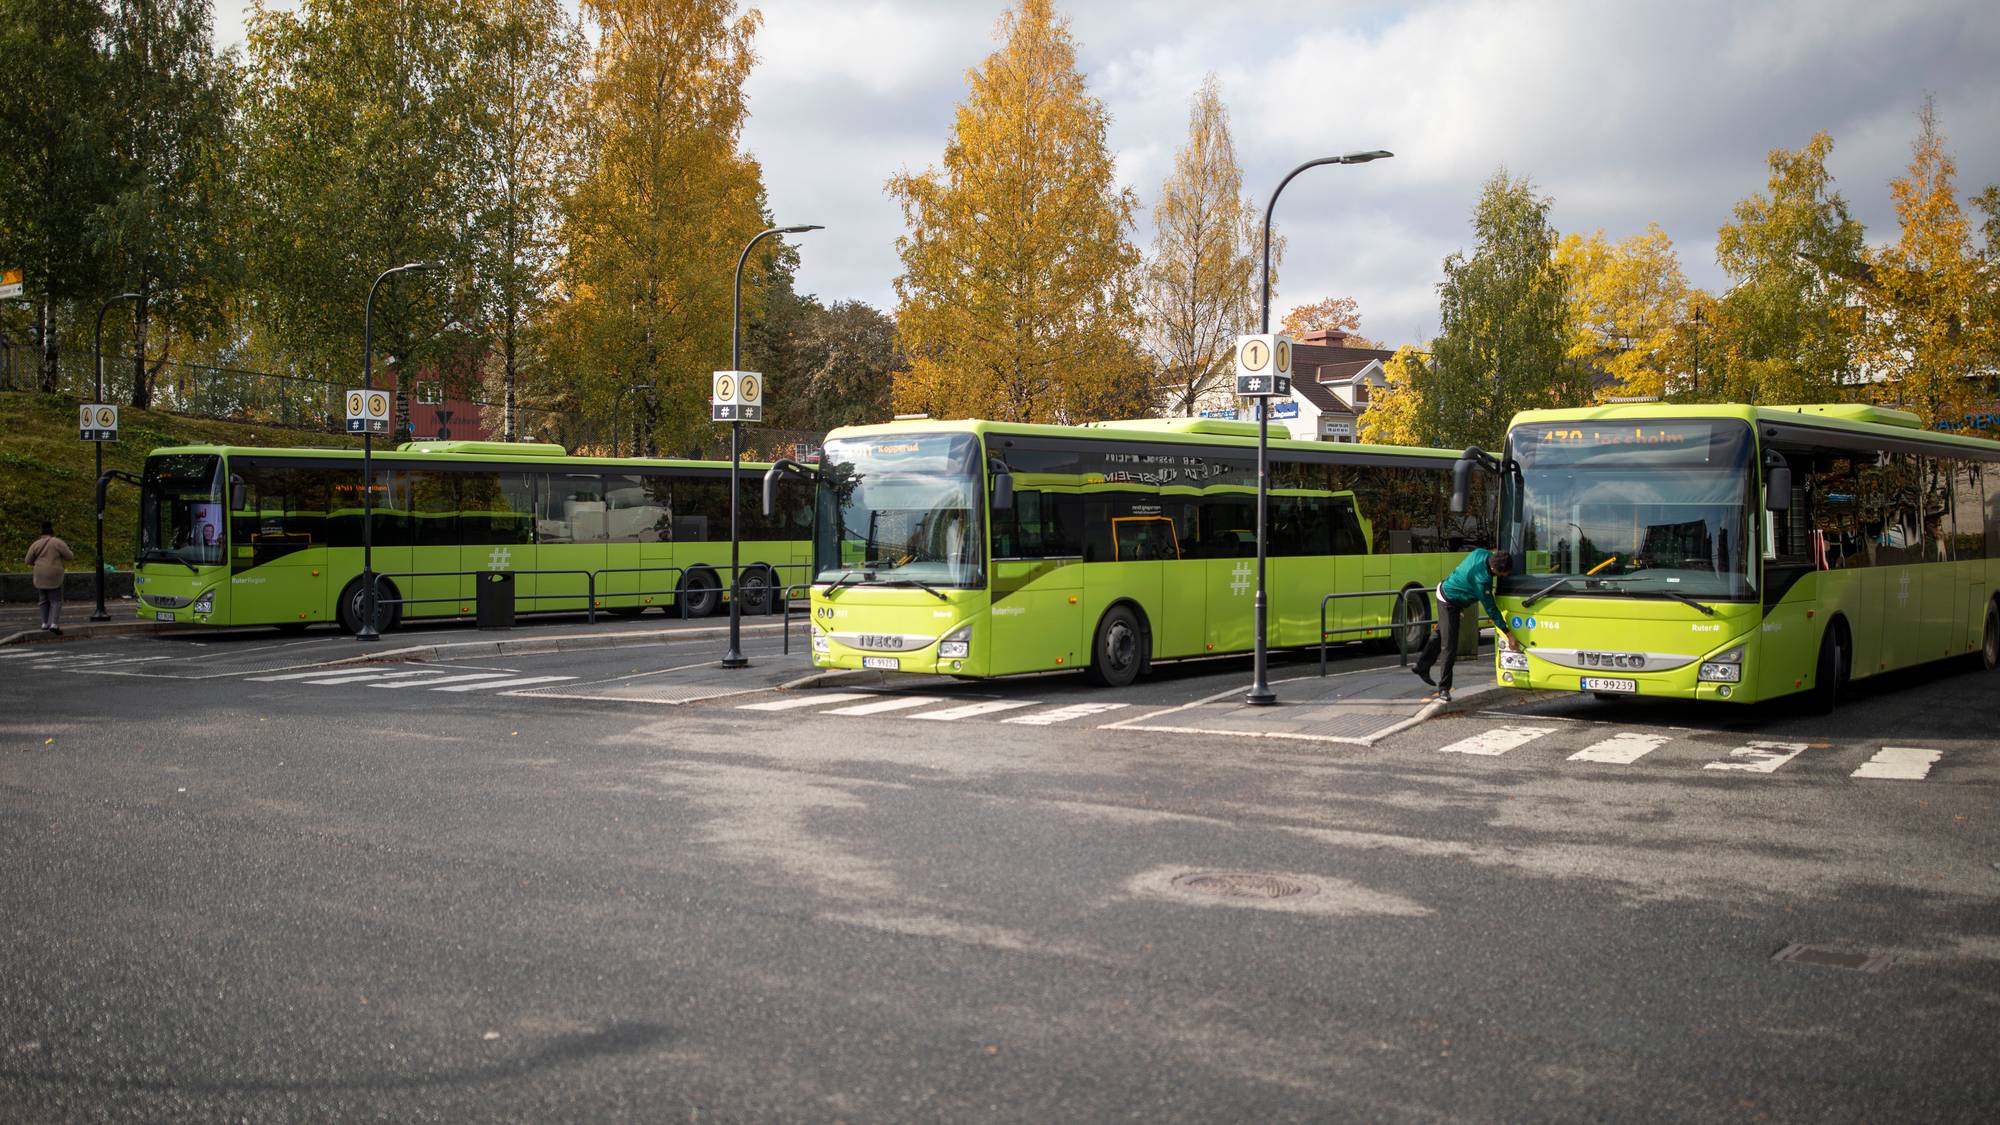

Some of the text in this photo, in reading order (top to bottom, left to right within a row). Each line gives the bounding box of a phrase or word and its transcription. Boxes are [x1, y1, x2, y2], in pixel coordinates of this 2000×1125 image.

[1250, 346, 1258, 365] 1
[722, 380, 729, 395] 2
[746, 381, 753, 396] 2
[353, 398, 359, 411] 3
[374, 399, 381, 411] 3
[84, 410, 89, 423] 4
[101, 411, 109, 423] 4
[859, 634, 903, 648] IVECO
[1577, 651, 1647, 669] IVECO
[1588, 679, 1633, 690] CF 99239
